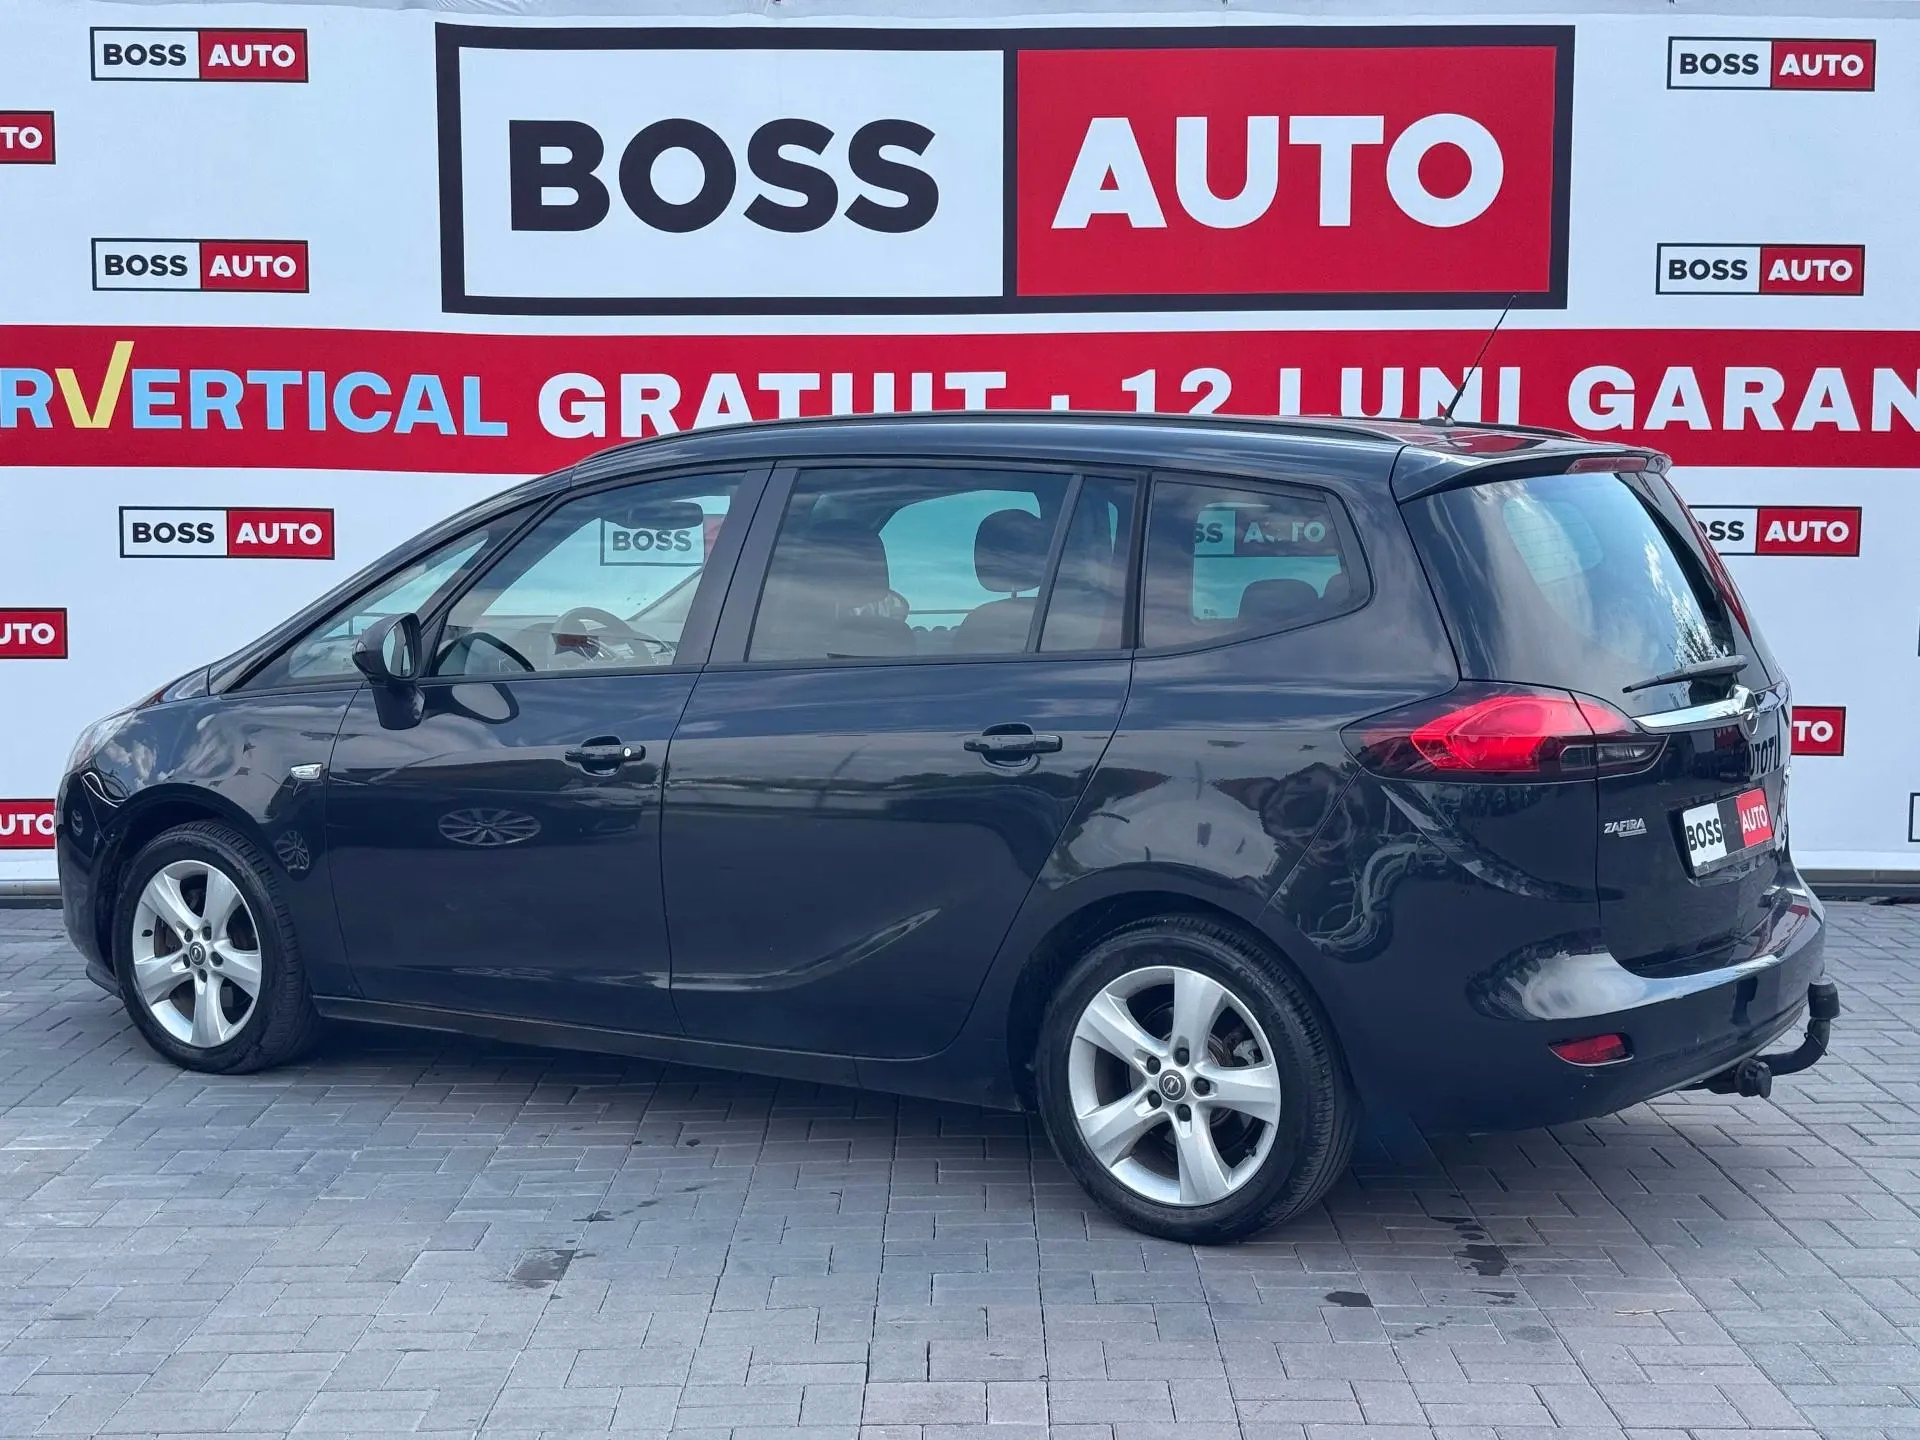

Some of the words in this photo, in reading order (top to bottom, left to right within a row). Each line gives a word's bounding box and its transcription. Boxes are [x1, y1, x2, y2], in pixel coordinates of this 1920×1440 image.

[103, 43, 187, 66] BOSS
[208, 44, 296, 67] AUTO
[1679, 53, 1759, 75] BOSS
[1778, 54, 1864, 77] AUTO
[509, 118, 939, 233] BOSS
[1051, 113, 1504, 228] AUTO
[104, 254, 188, 277] BOSS
[209, 255, 297, 278] AUTO
[1668, 258, 1748, 281] BOSS
[1768, 259, 1853, 282] AUTO
[538, 371, 1007, 438] GRATUIT
[1121, 368, 1233, 415] 12
[1278, 366, 1521, 426] LUNI
[1567, 365, 1920, 432] GARAN
[132, 522, 215, 543] BOSS
[235, 523, 322, 545] AUTO
[612, 530, 692, 552] BOSS
[1243, 521, 1326, 544] ATO
[1697, 520, 1744, 541] SS
[1764, 520, 1849, 543] AUTO
[1604, 817, 1646, 834] ZAFIRA
[1685, 818, 1723, 851] BOSS
[1741, 805, 1768, 834] AUTO
